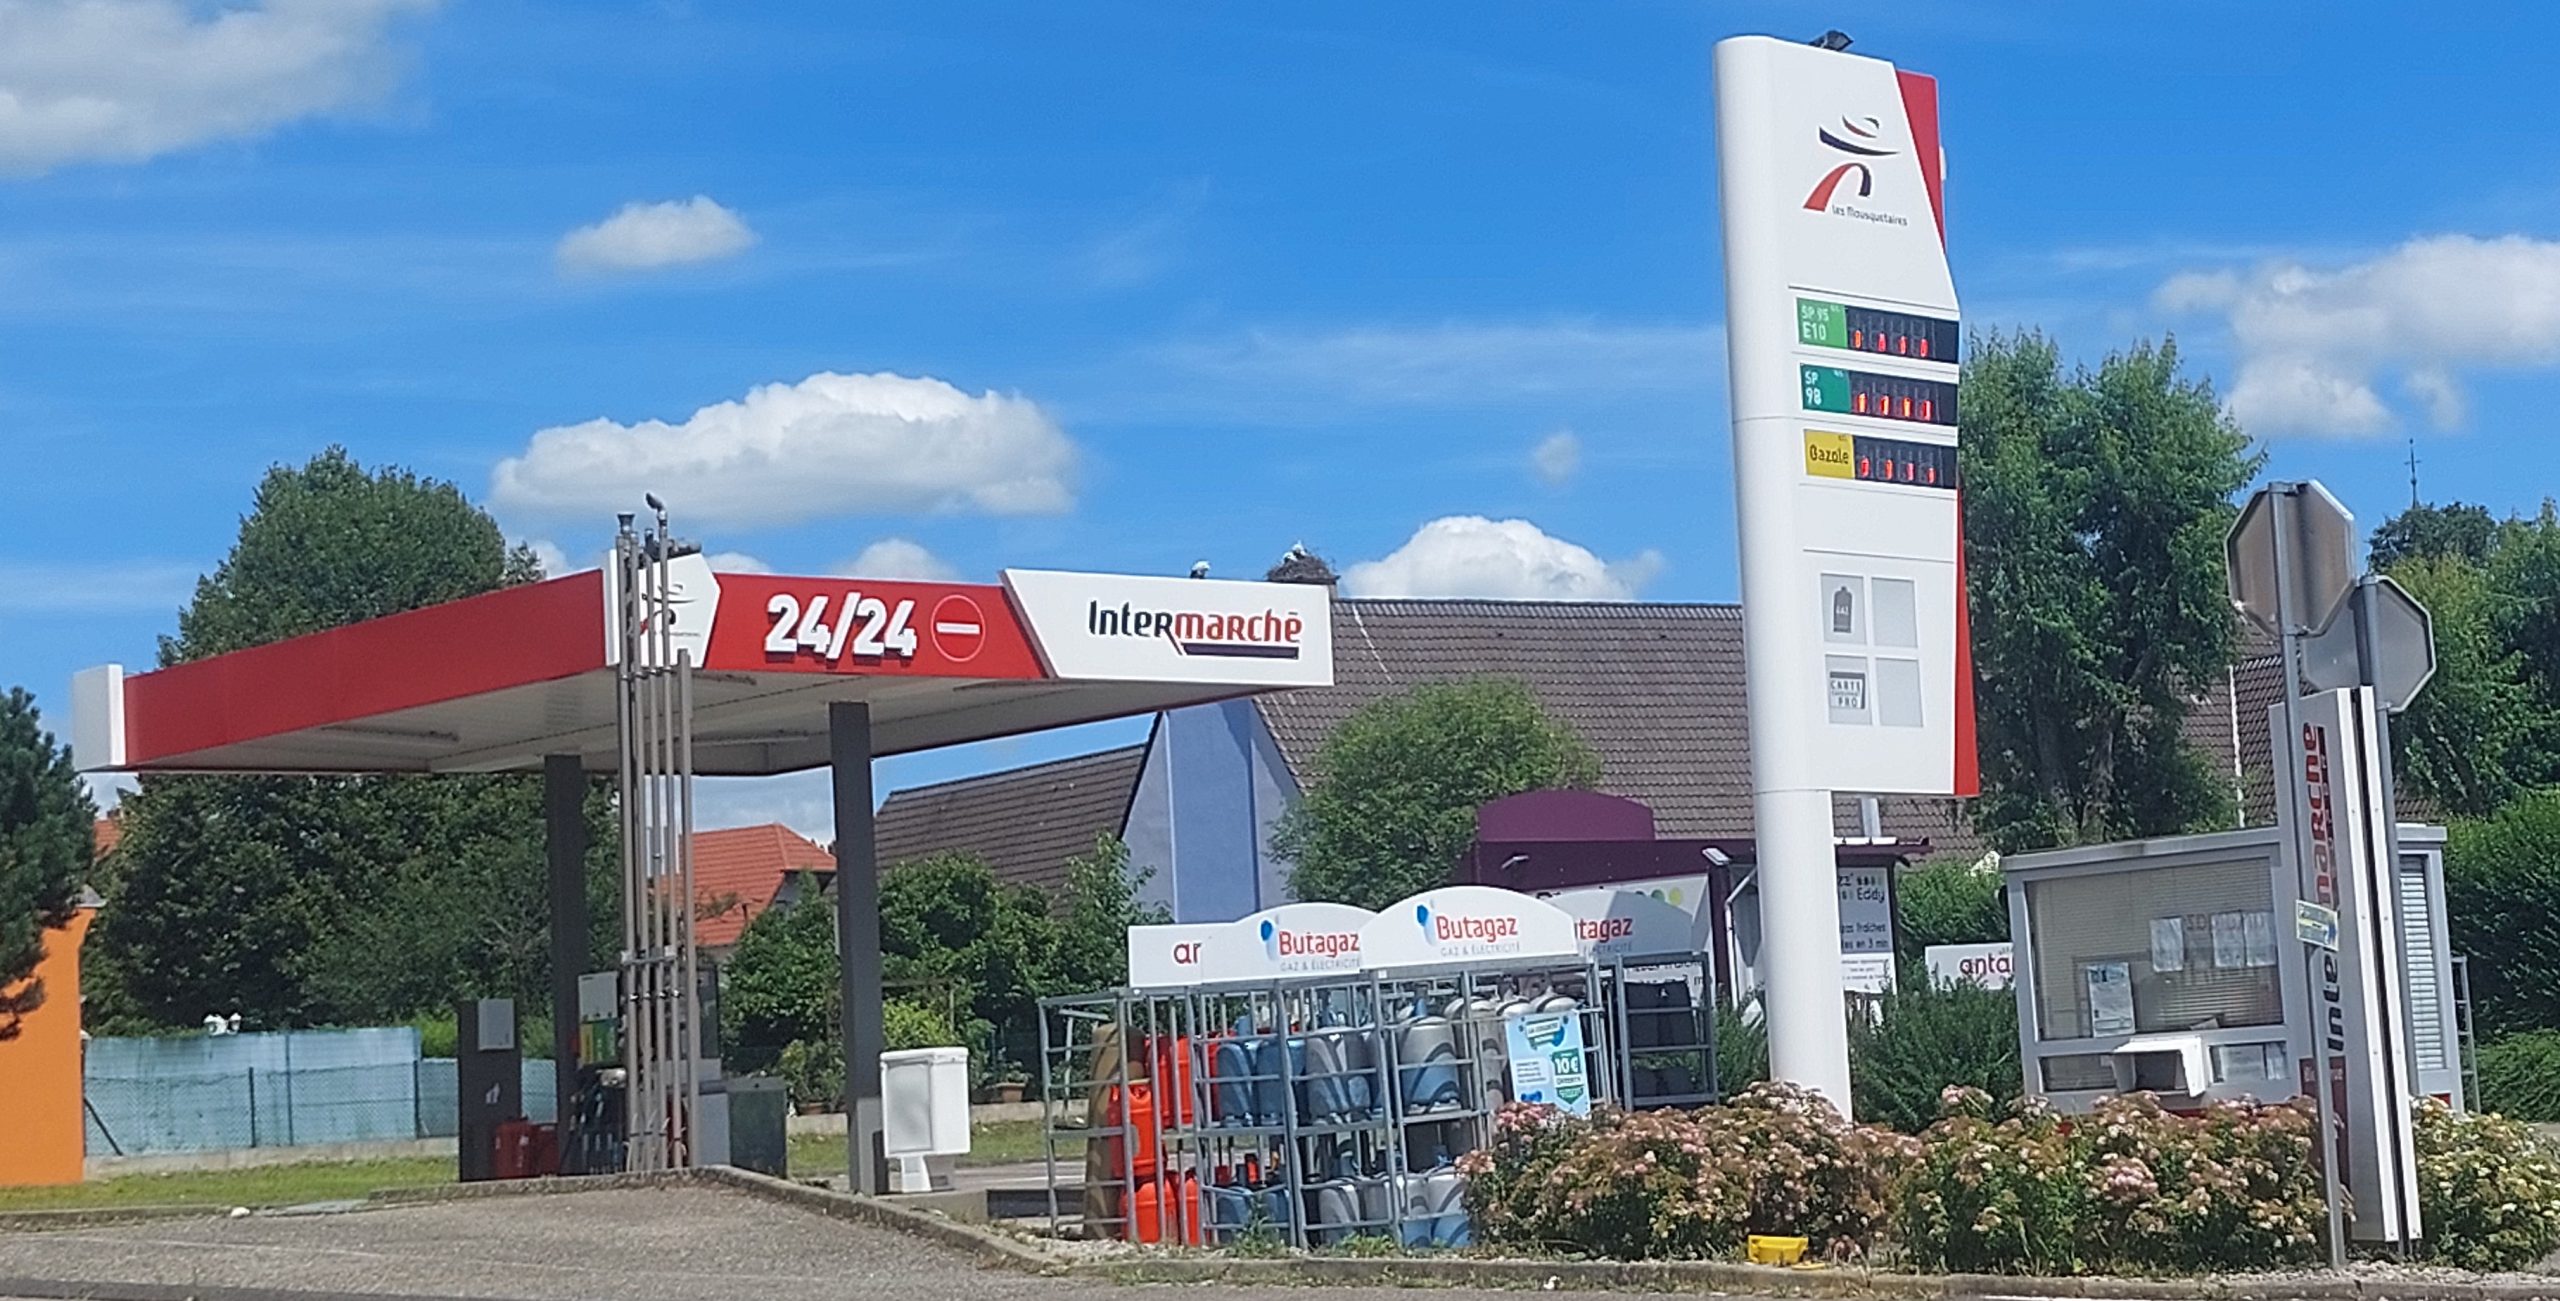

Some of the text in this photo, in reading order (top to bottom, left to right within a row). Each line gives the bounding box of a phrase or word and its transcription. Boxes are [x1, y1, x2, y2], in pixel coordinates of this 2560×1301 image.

[1803, 321, 1827, 341] E10
[1805, 370, 1819, 386] SP
[1805, 387, 1822, 406] 98
[1810, 443, 1849, 465] Gazole
[765, 592, 917, 661] 24/24
[1089, 600, 1303, 656] Intermarché
[1857, 887, 1886, 904] Eddy
[1436, 915, 1518, 943] Butagaz
[1278, 930, 1360, 958] Butagaz
[1555, 1055, 1579, 1075] 10€
